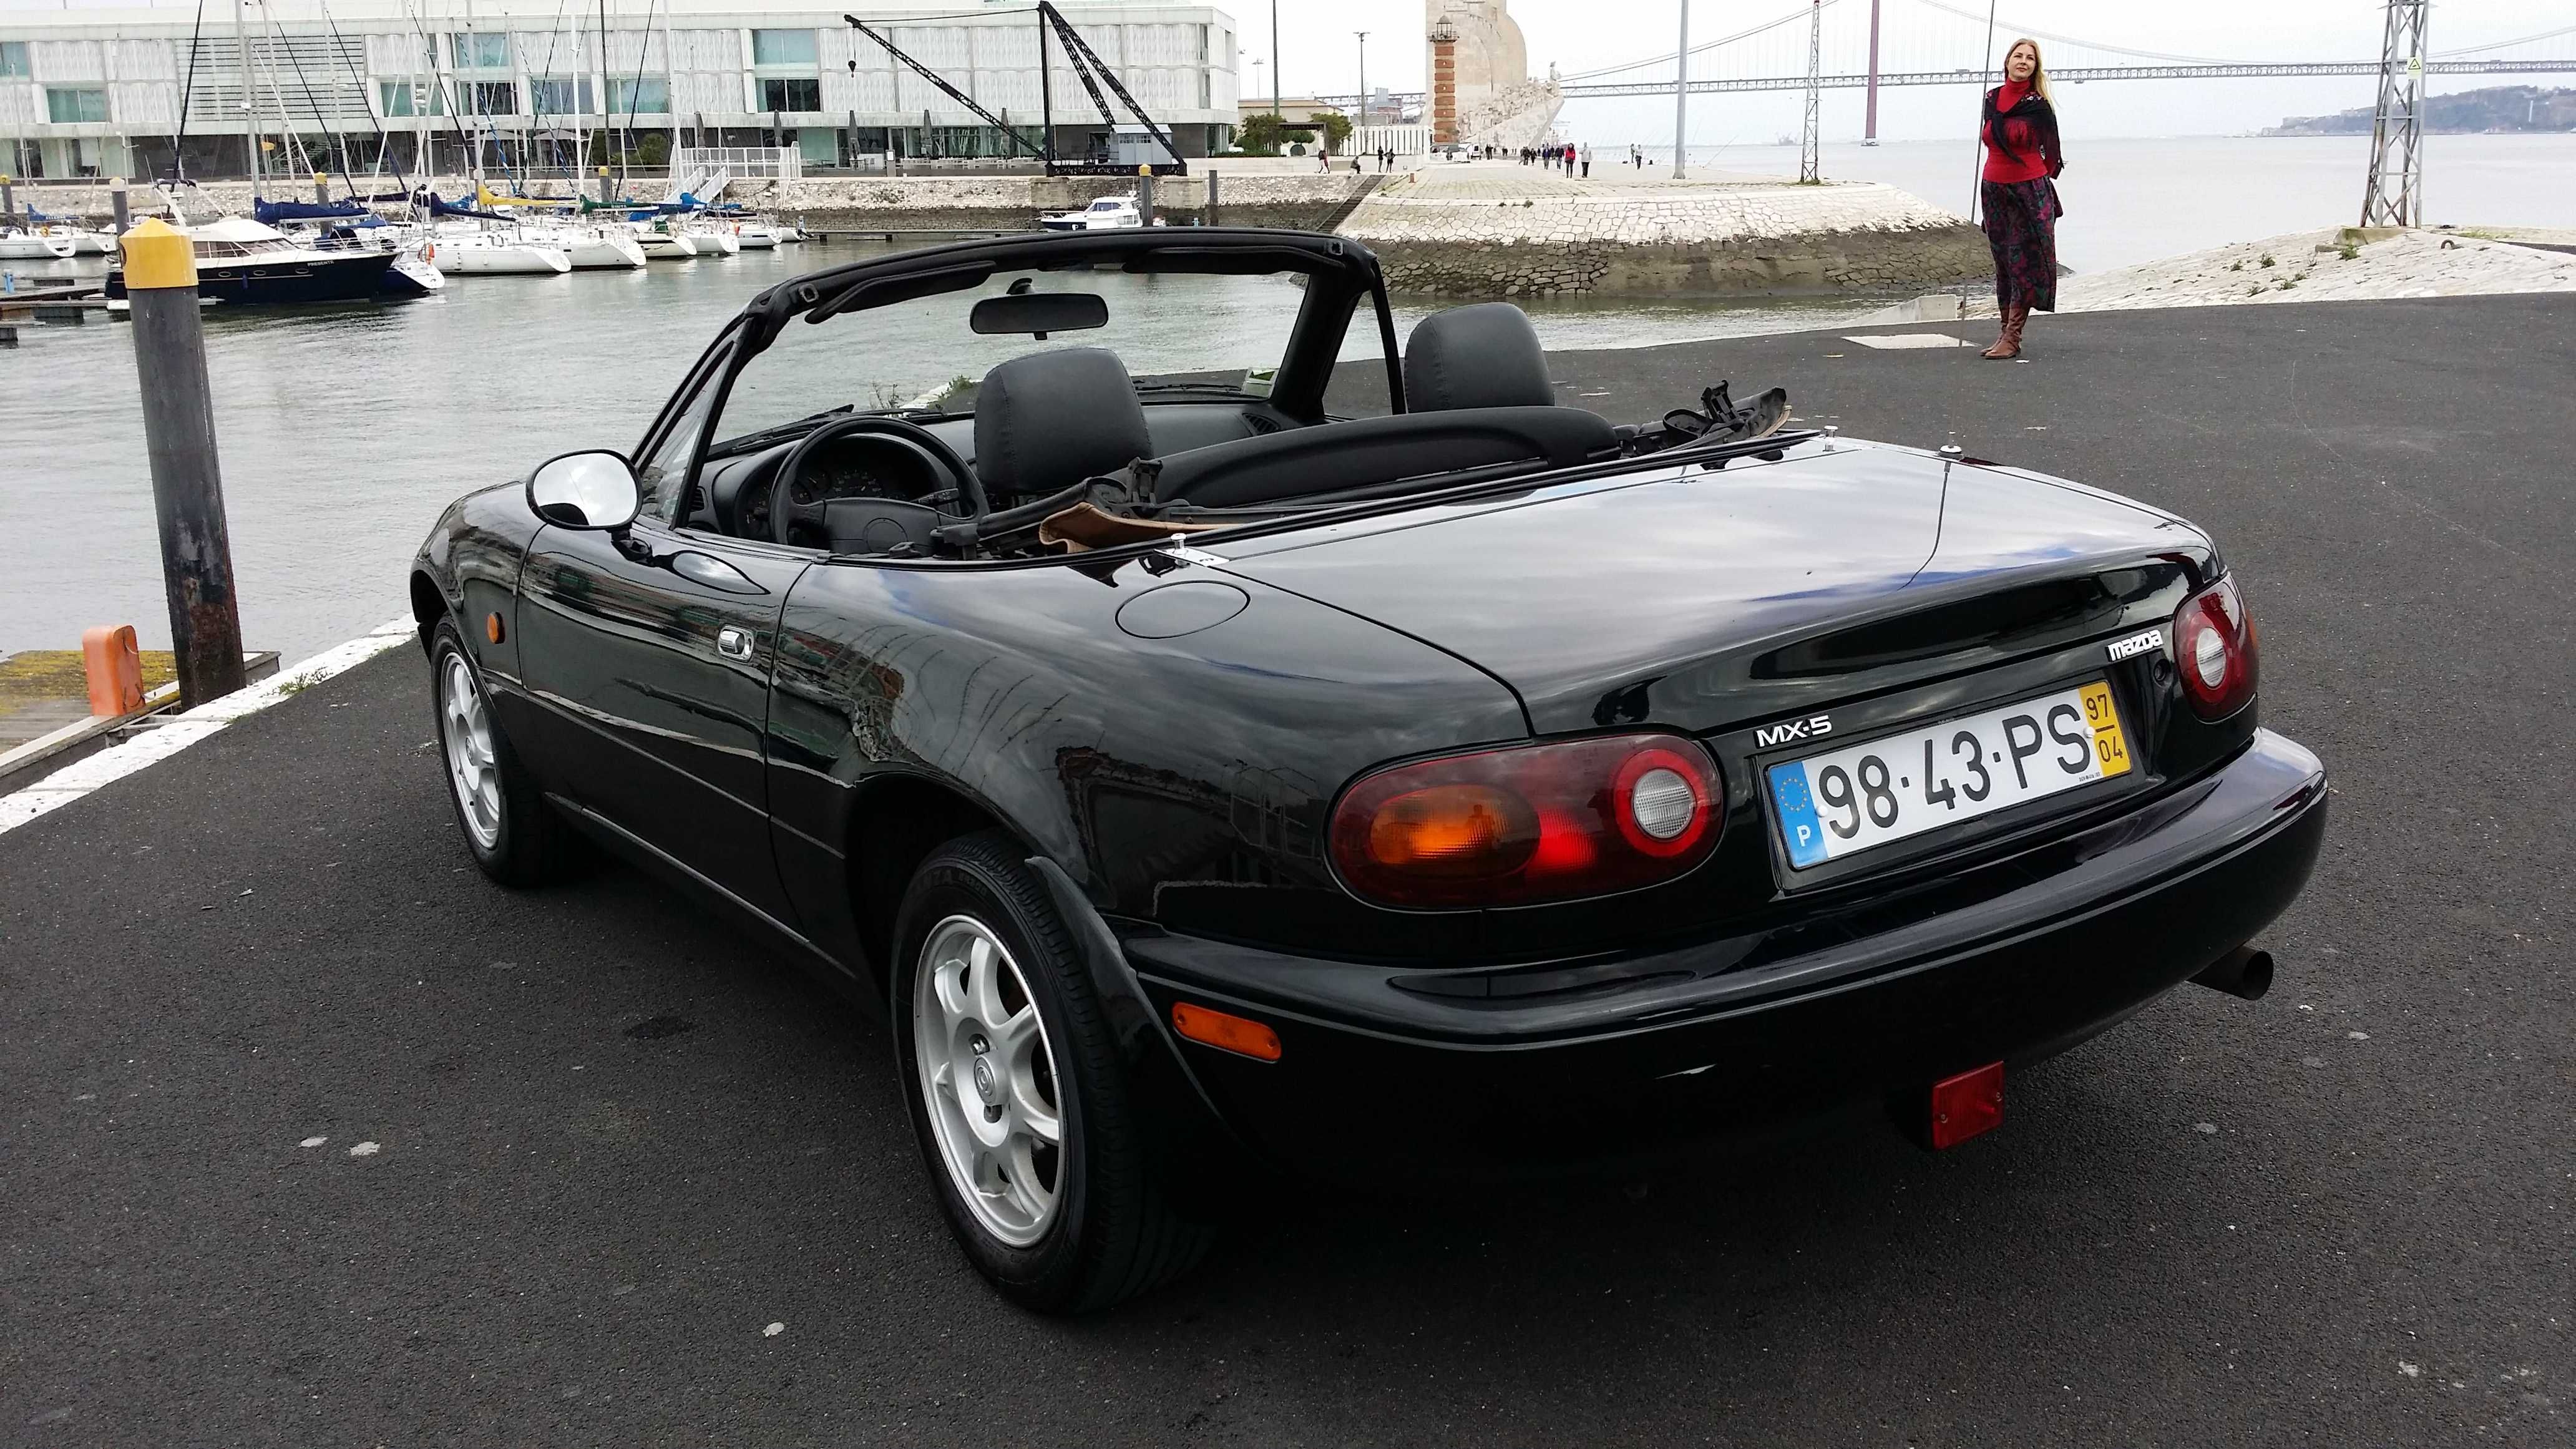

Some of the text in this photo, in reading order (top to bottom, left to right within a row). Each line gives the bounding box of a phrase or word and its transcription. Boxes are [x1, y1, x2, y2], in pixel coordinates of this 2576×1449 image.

[2086, 693, 2108, 720] 97
[1756, 715, 1832, 747] MX-5
[2098, 736, 2123, 763] 04
[1797, 824, 1811, 847] P
